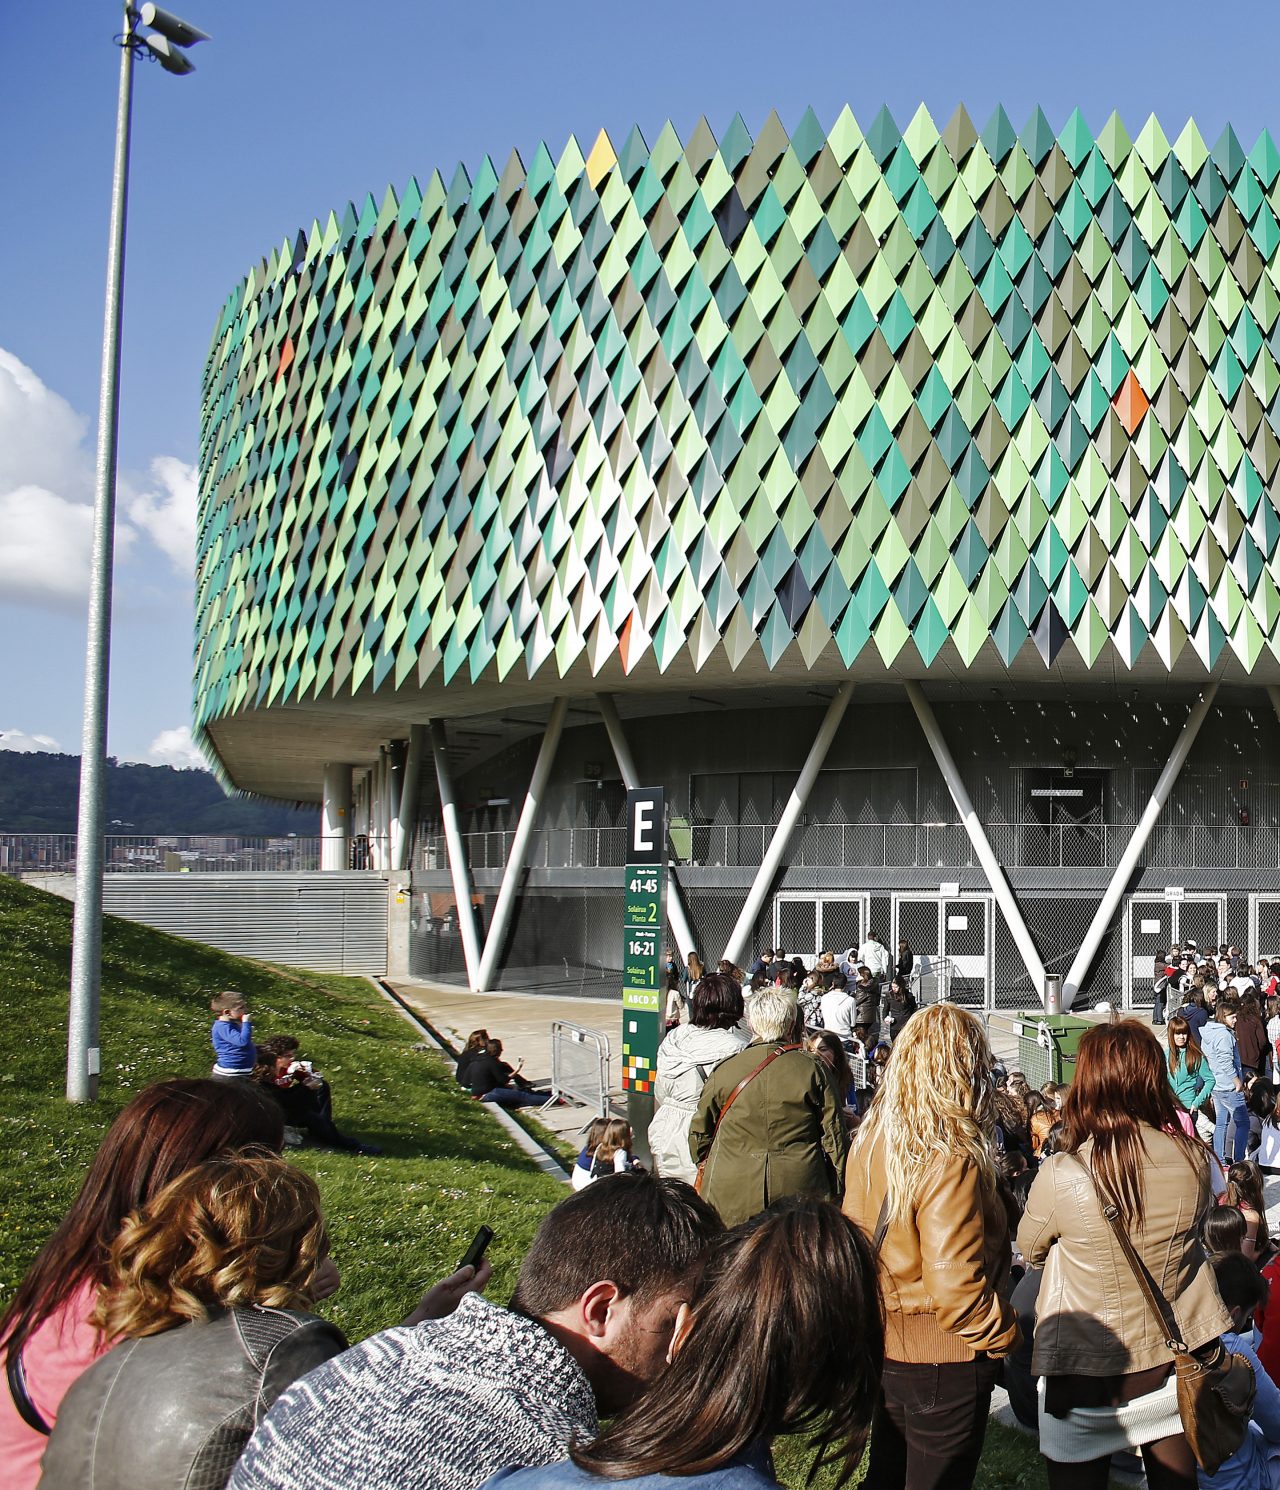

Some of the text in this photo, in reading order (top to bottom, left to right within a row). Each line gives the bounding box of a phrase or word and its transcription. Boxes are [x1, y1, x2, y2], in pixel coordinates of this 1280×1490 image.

[634, 801, 654, 851] E
[630, 879, 658, 893] 41-45
[648, 903, 657, 922] 2
[629, 941, 655, 955] 16-21
[632, 976, 645, 984] Planta
[649, 966, 655, 985] 1
[628, 995, 649, 1004] ABCD
